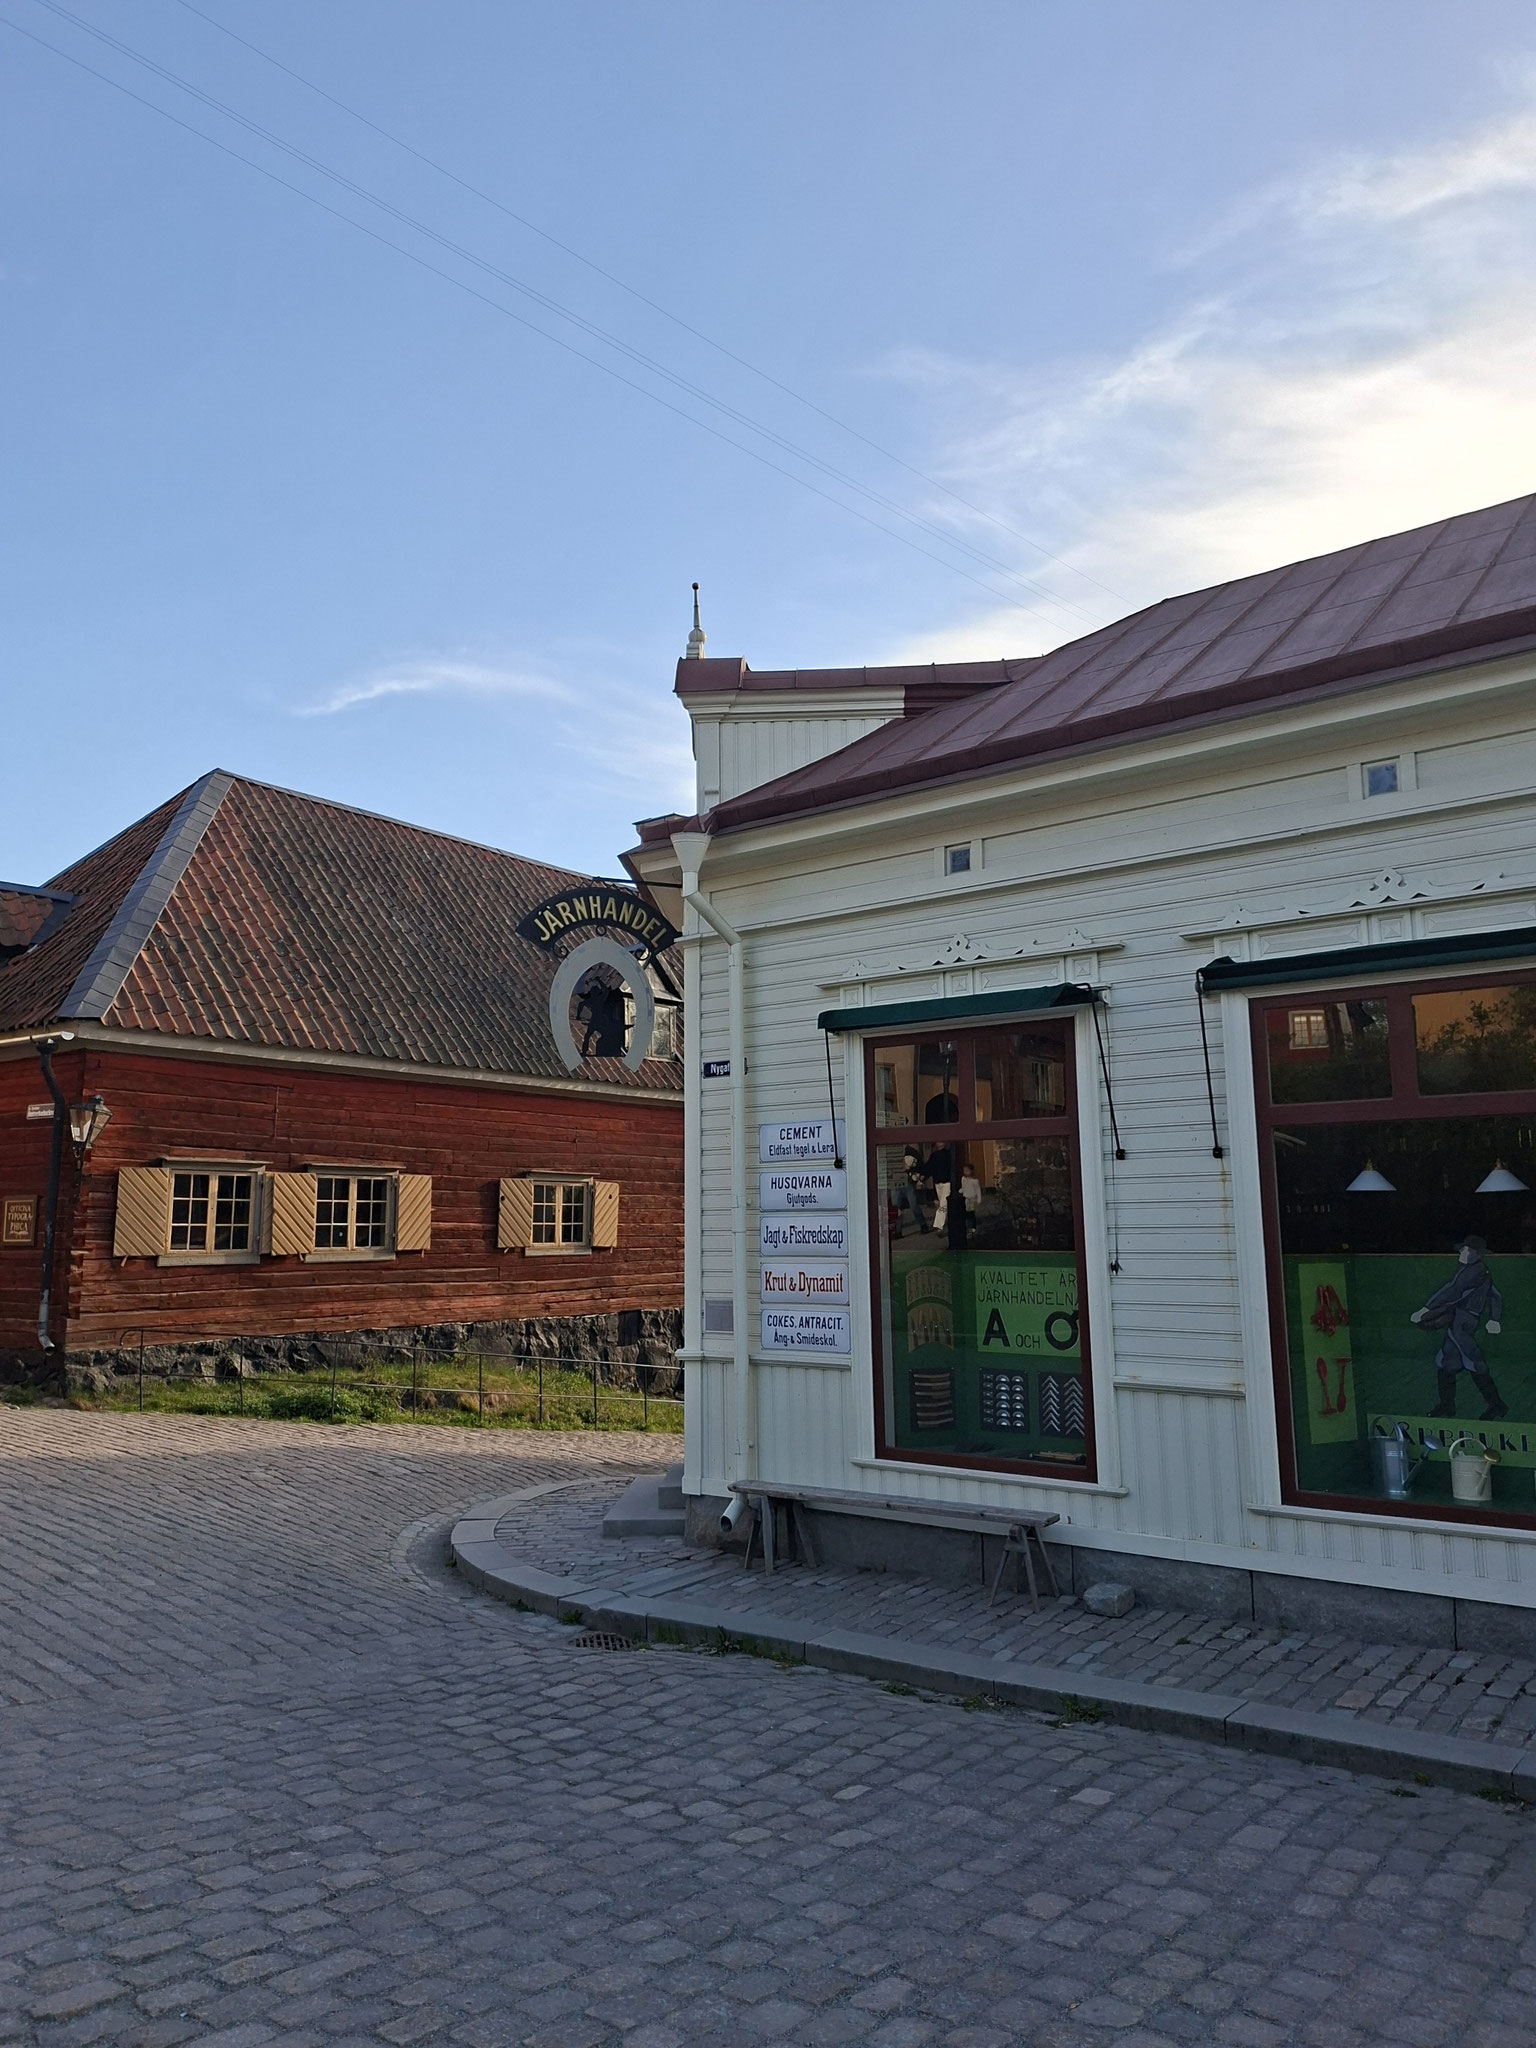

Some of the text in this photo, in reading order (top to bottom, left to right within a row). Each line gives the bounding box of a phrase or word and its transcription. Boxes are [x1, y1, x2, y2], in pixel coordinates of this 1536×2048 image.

[534, 895, 667, 948] JÄRNHANDEL
[780, 1126, 822, 1141] CEMENT
[769, 1142, 834, 1157] Eldfast tegel & Lera
[771, 1175, 832, 1190] HUSQVARNA
[786, 1192, 819, 1207] Gjutgods.
[763, 1225, 844, 1249] Jagt & Fiskredskap
[765, 1271, 843, 1297] Krut & Dynamit
[980, 1269, 1077, 1287] KVALITET ÄR
[978, 1286, 1079, 1306] JÄRNHANDELN
[799, 1316, 844, 1330] ANTRACIT.
[982, 1308, 1011, 1348] A
[1015, 1334, 1040, 1349] OCH
[797, 1333, 838, 1347] Smideskol.
